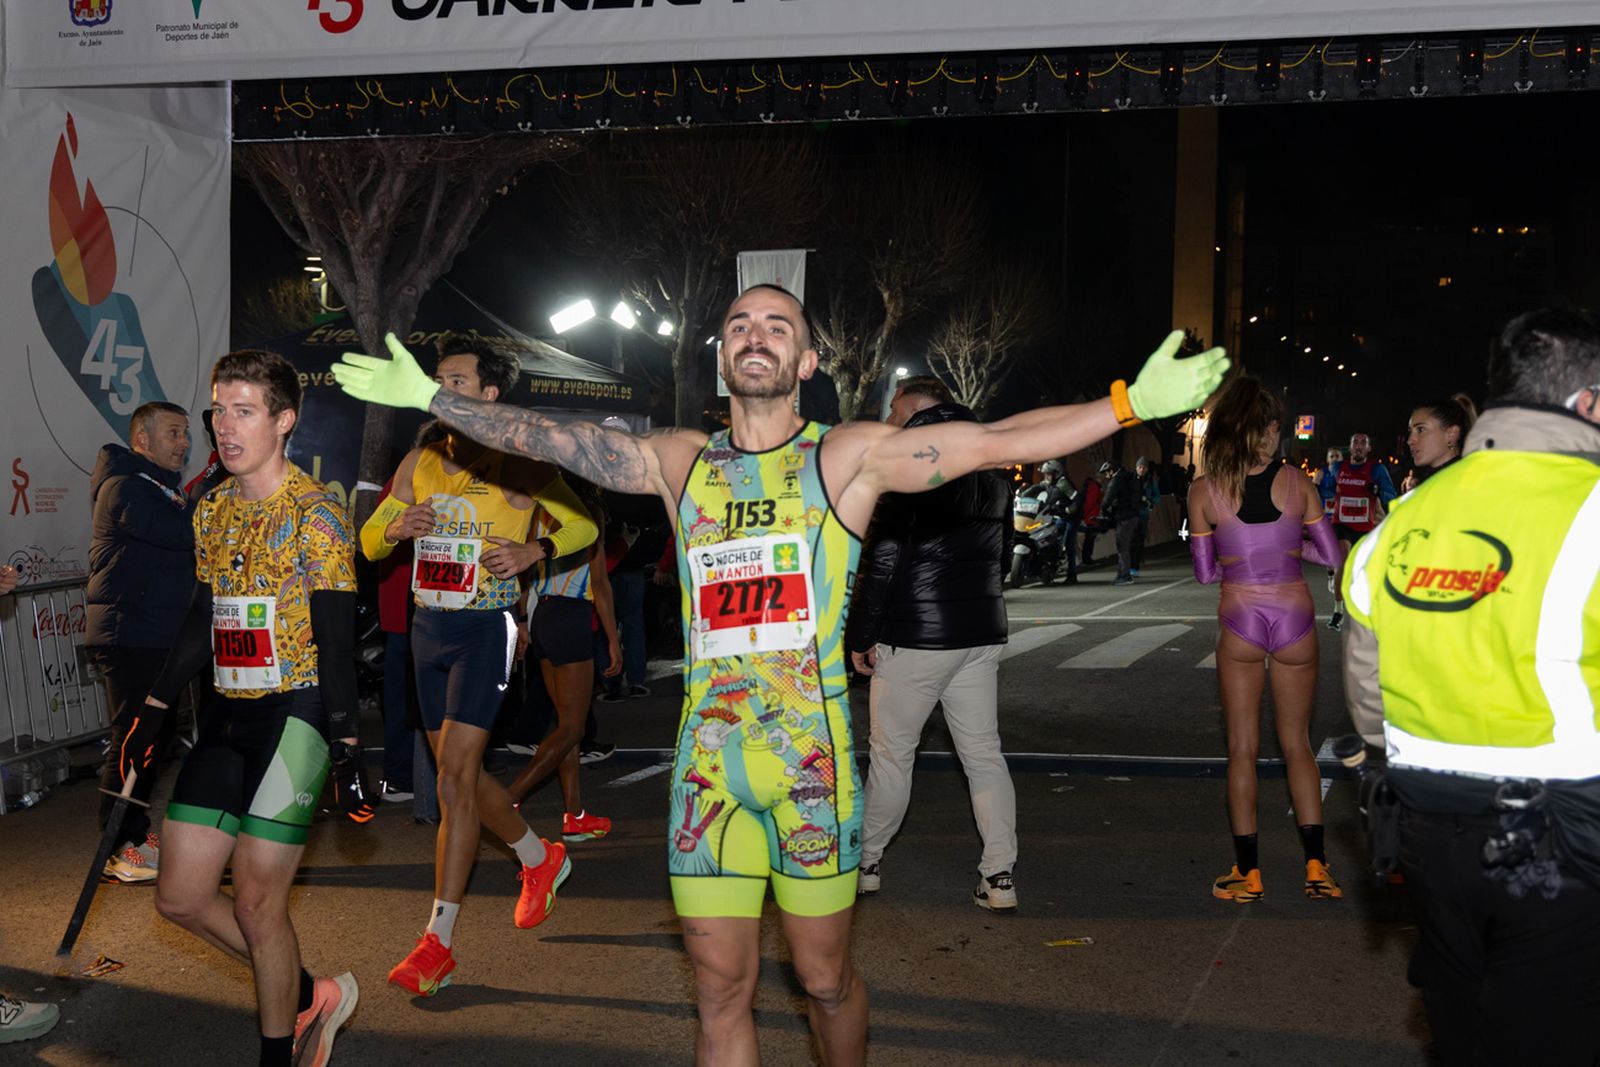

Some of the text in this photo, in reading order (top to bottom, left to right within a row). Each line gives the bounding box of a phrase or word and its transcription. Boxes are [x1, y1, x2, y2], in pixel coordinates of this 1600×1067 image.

[82, 28, 124, 38] Ayuntamiento
[155, 20, 239, 33] Patronato Municipal de
[165, 30, 229, 43] Deportes de Jaén
[80, 318, 145, 416] 43
[529, 378, 633, 401] www.evedeport.es
[725, 499, 776, 529] 1153
[447, 521, 494, 536] SENT
[716, 552, 748, 567] NOCHE
[750, 550, 763, 561] DE
[423, 561, 464, 585] 3229
[726, 562, 764, 580] ANTÓN
[1404, 563, 1505, 601] proseja
[717, 577, 785, 617] 2772
[786, 834, 835, 854] BOOM!
